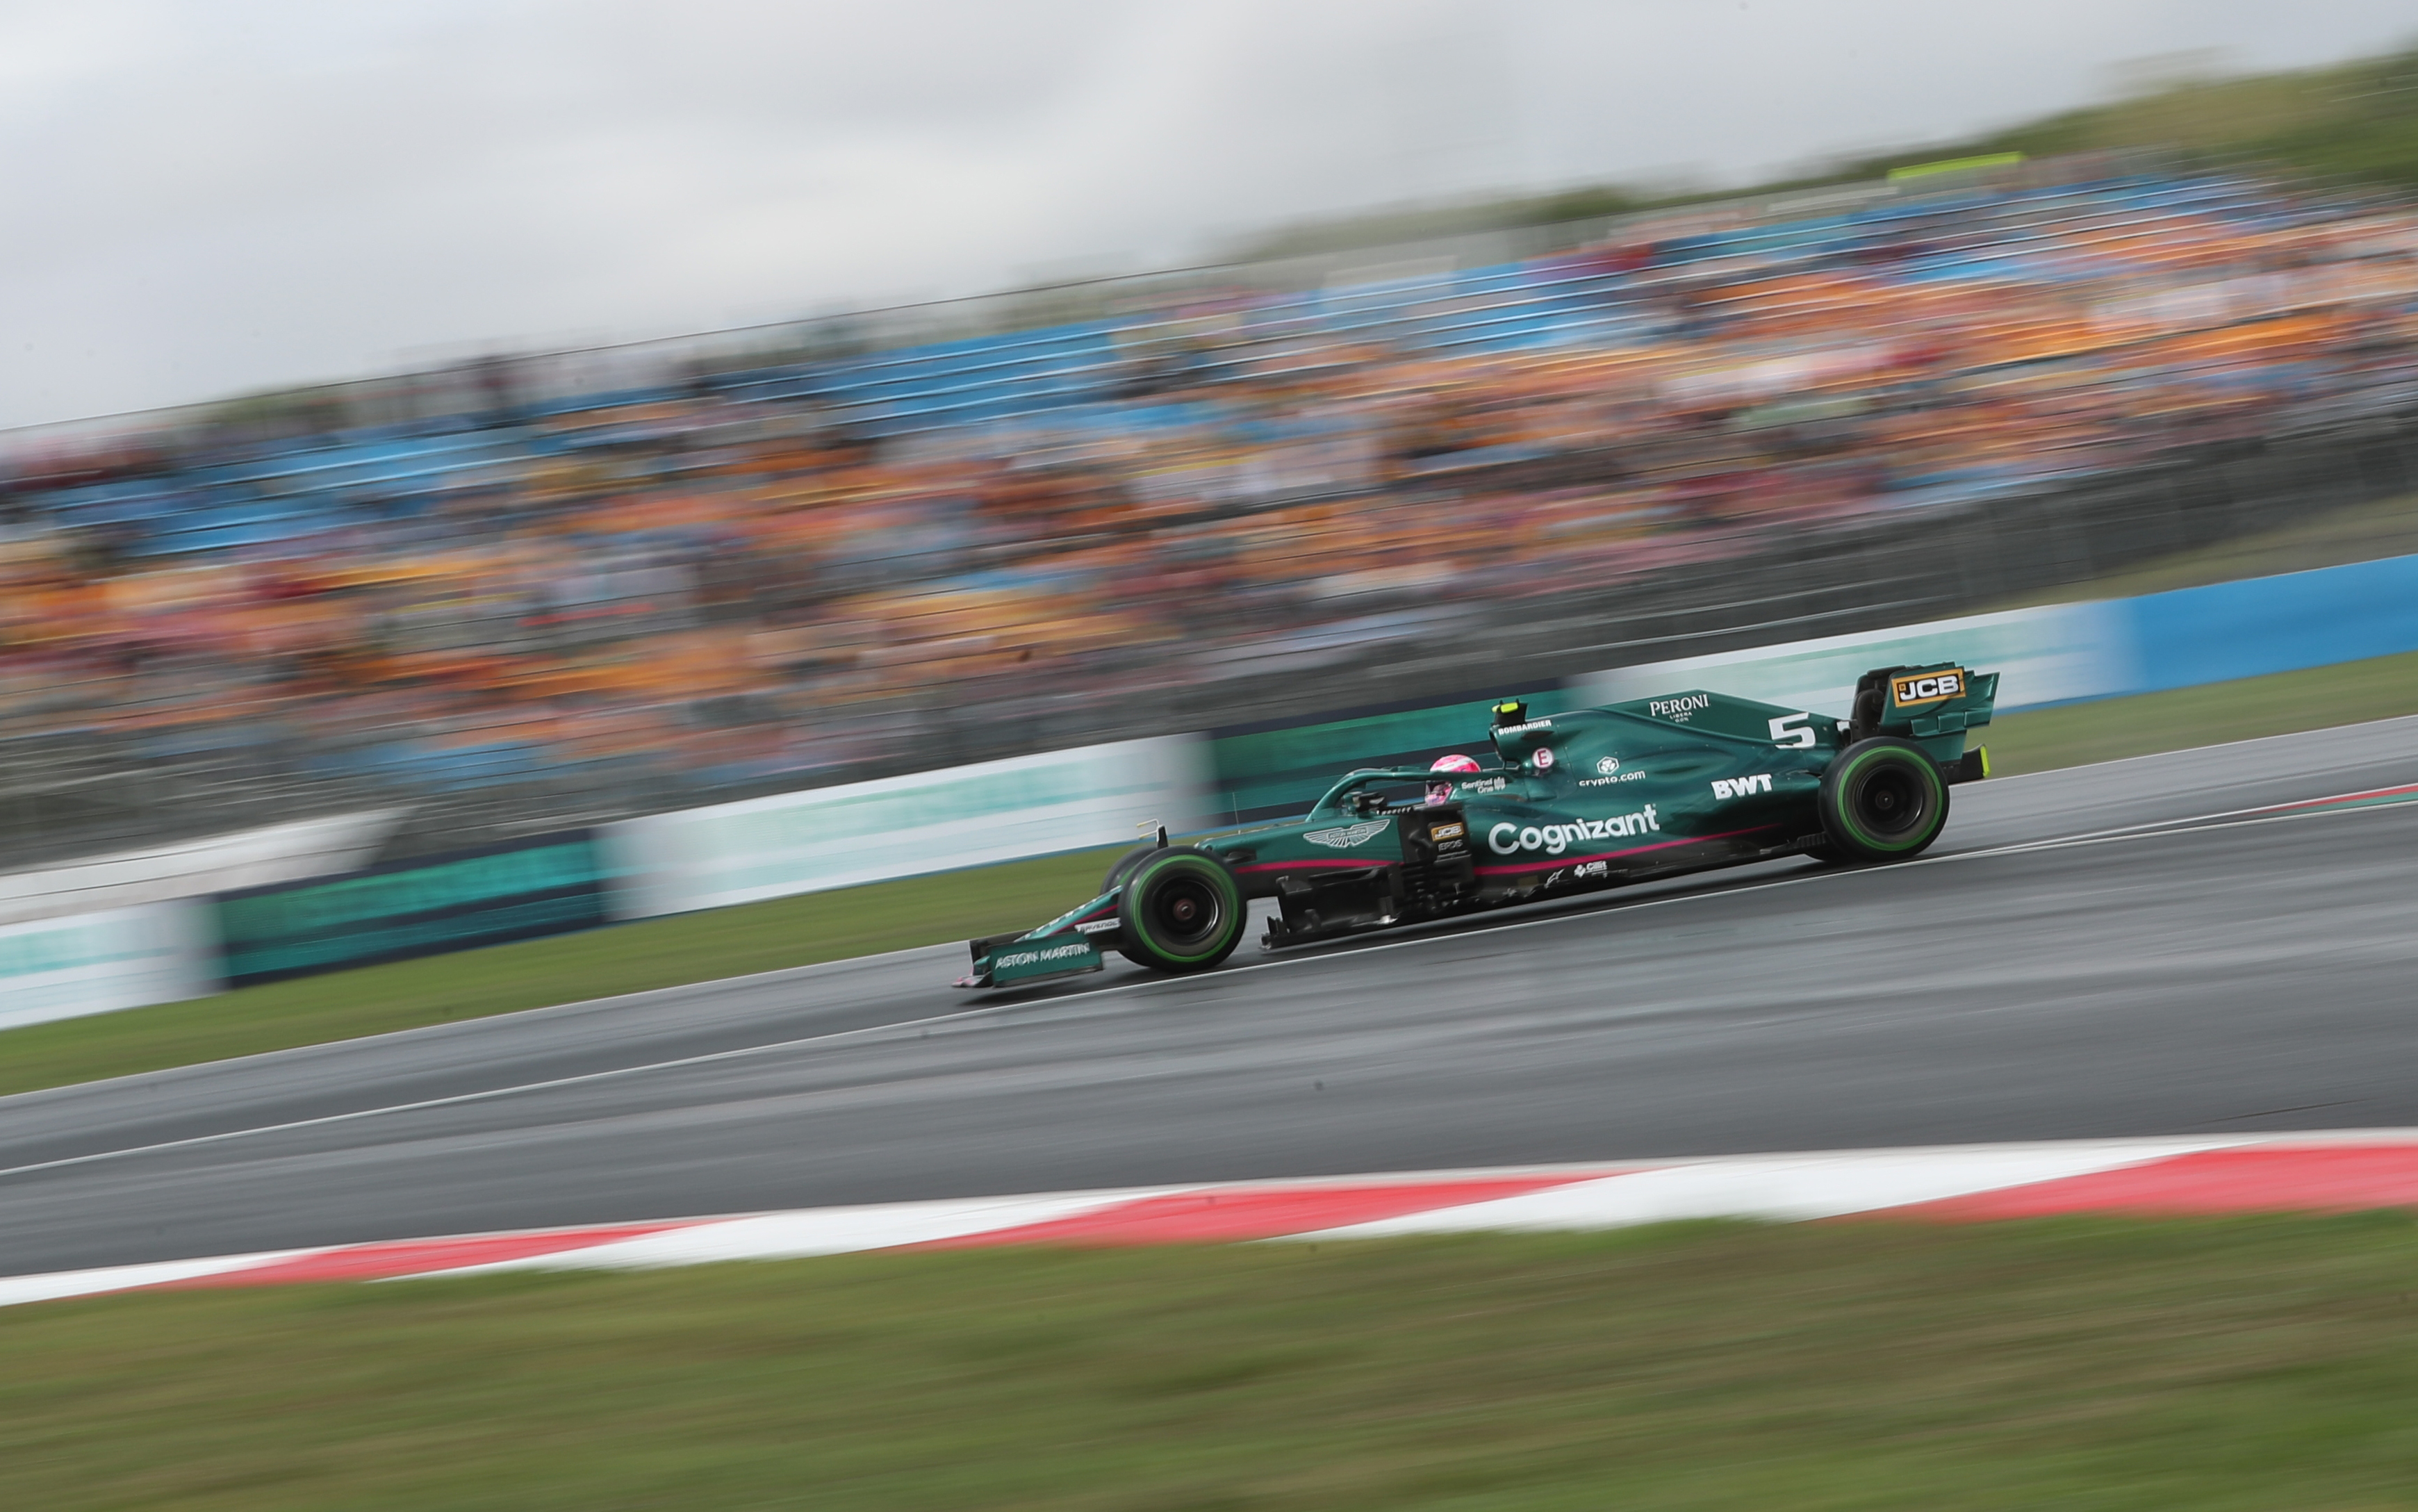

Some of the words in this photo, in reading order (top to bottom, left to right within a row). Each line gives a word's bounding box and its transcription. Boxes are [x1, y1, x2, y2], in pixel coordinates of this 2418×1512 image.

[1900, 675, 1959, 700] JCB
[1649, 694, 1709, 716] PERONI
[1498, 719, 1552, 735] BOMBARDIER
[1768, 712, 1816, 749] 5
[1579, 771, 1645, 787] crypto.com
[1711, 773, 1773, 800] BWT
[1434, 825, 1461, 838] JCB
[1488, 803, 1660, 855] Cognizant
[995, 951, 1039, 969] ASTON
[1040, 942, 1090, 962] MARTIN
